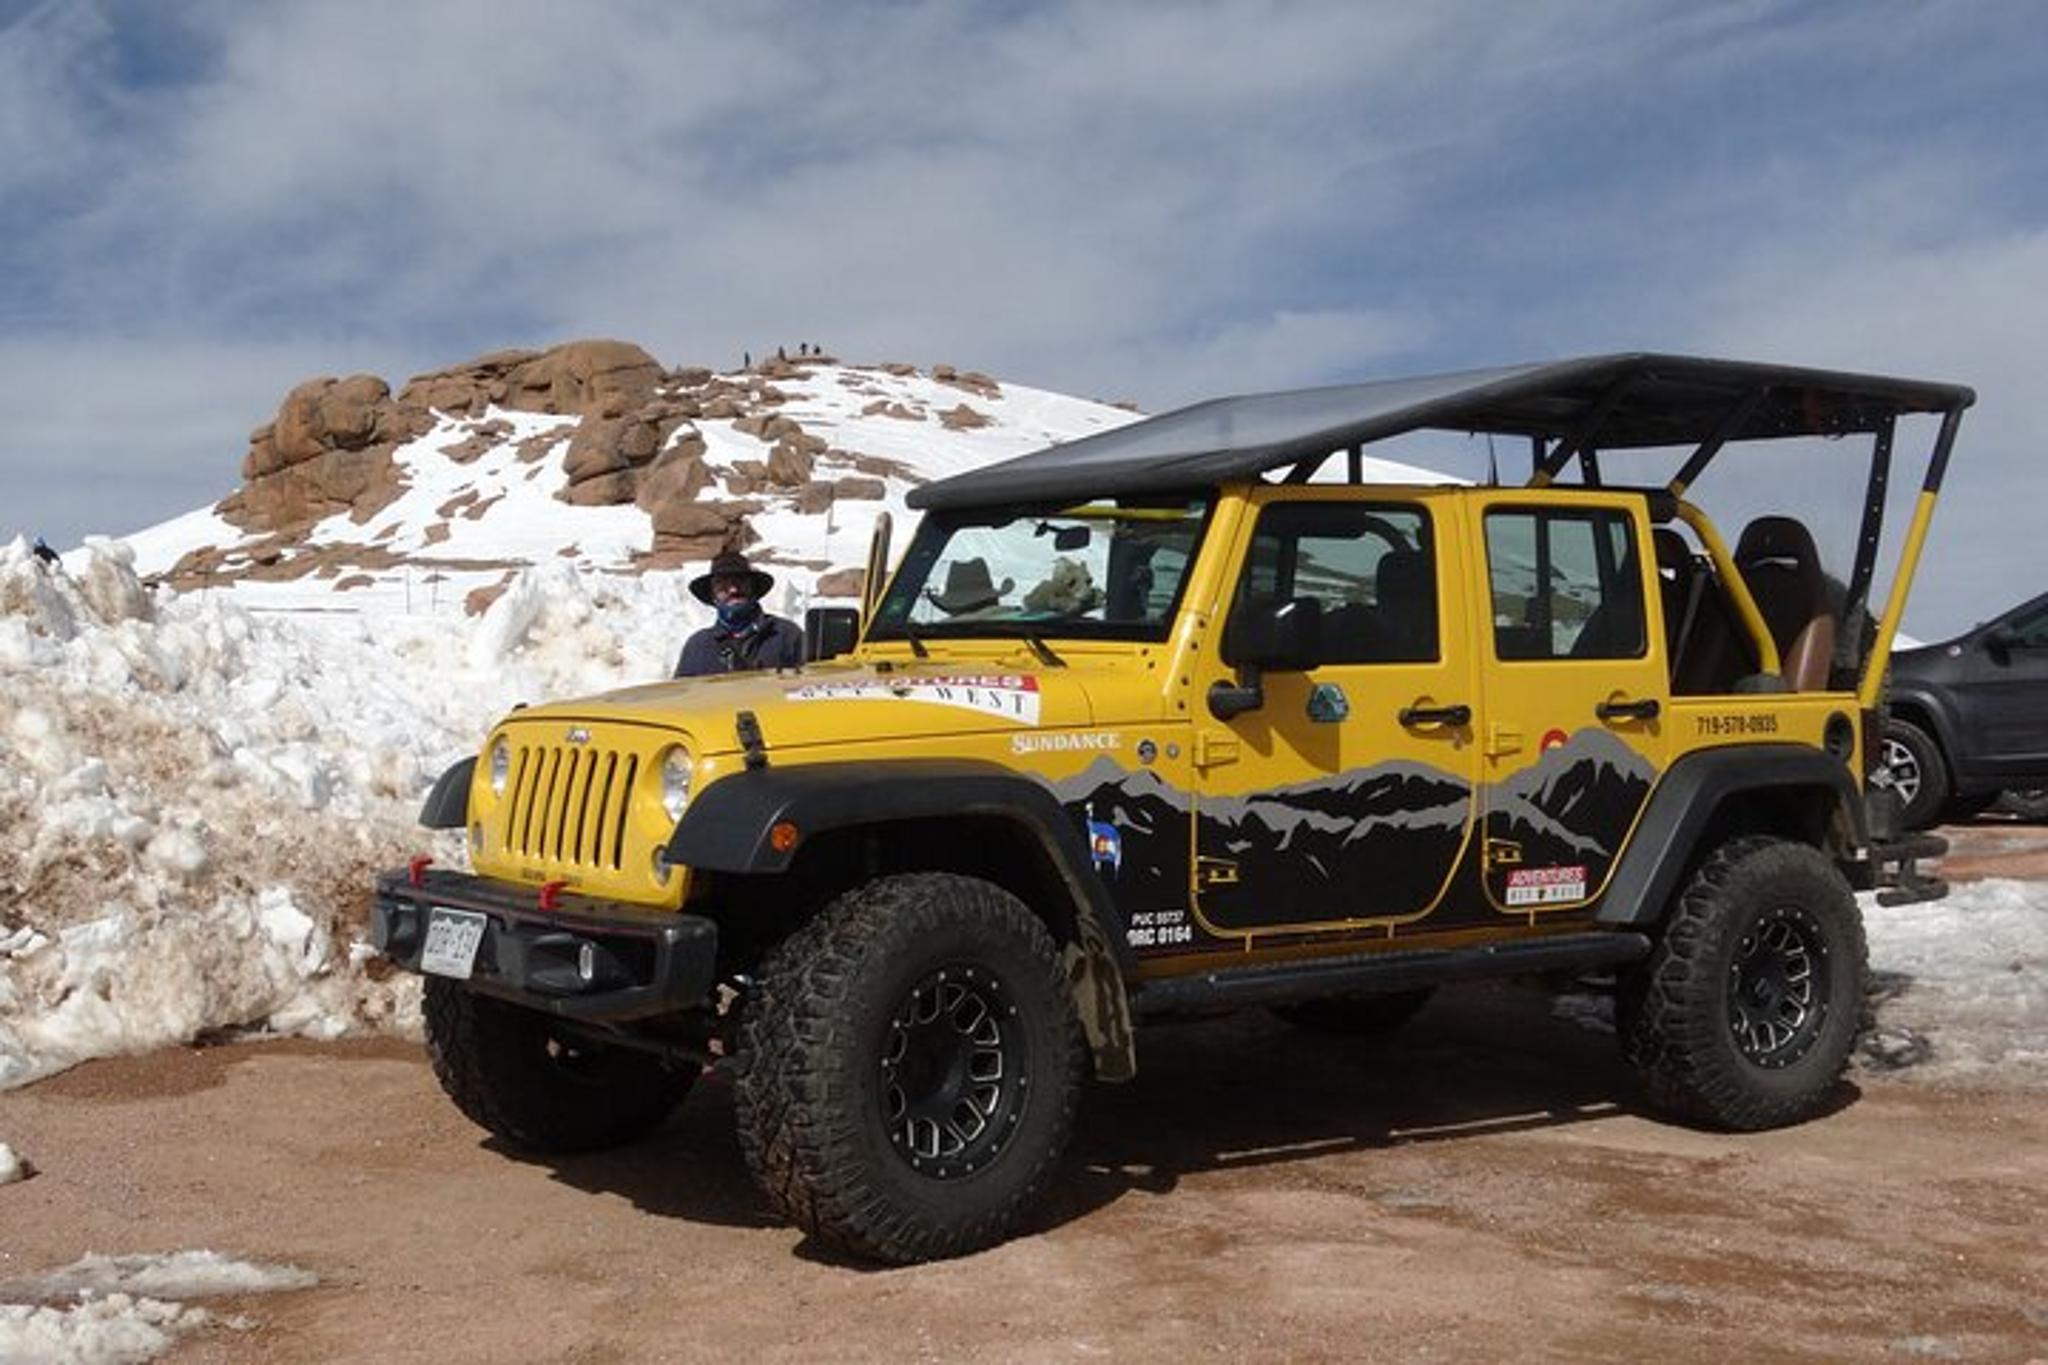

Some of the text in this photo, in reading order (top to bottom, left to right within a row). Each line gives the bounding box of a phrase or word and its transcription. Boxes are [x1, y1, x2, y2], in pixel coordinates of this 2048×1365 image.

[935, 686, 1024, 715] WEST
[1509, 866, 1585, 888] ADVENTURES
[1157, 924, 1192, 945] 0164
